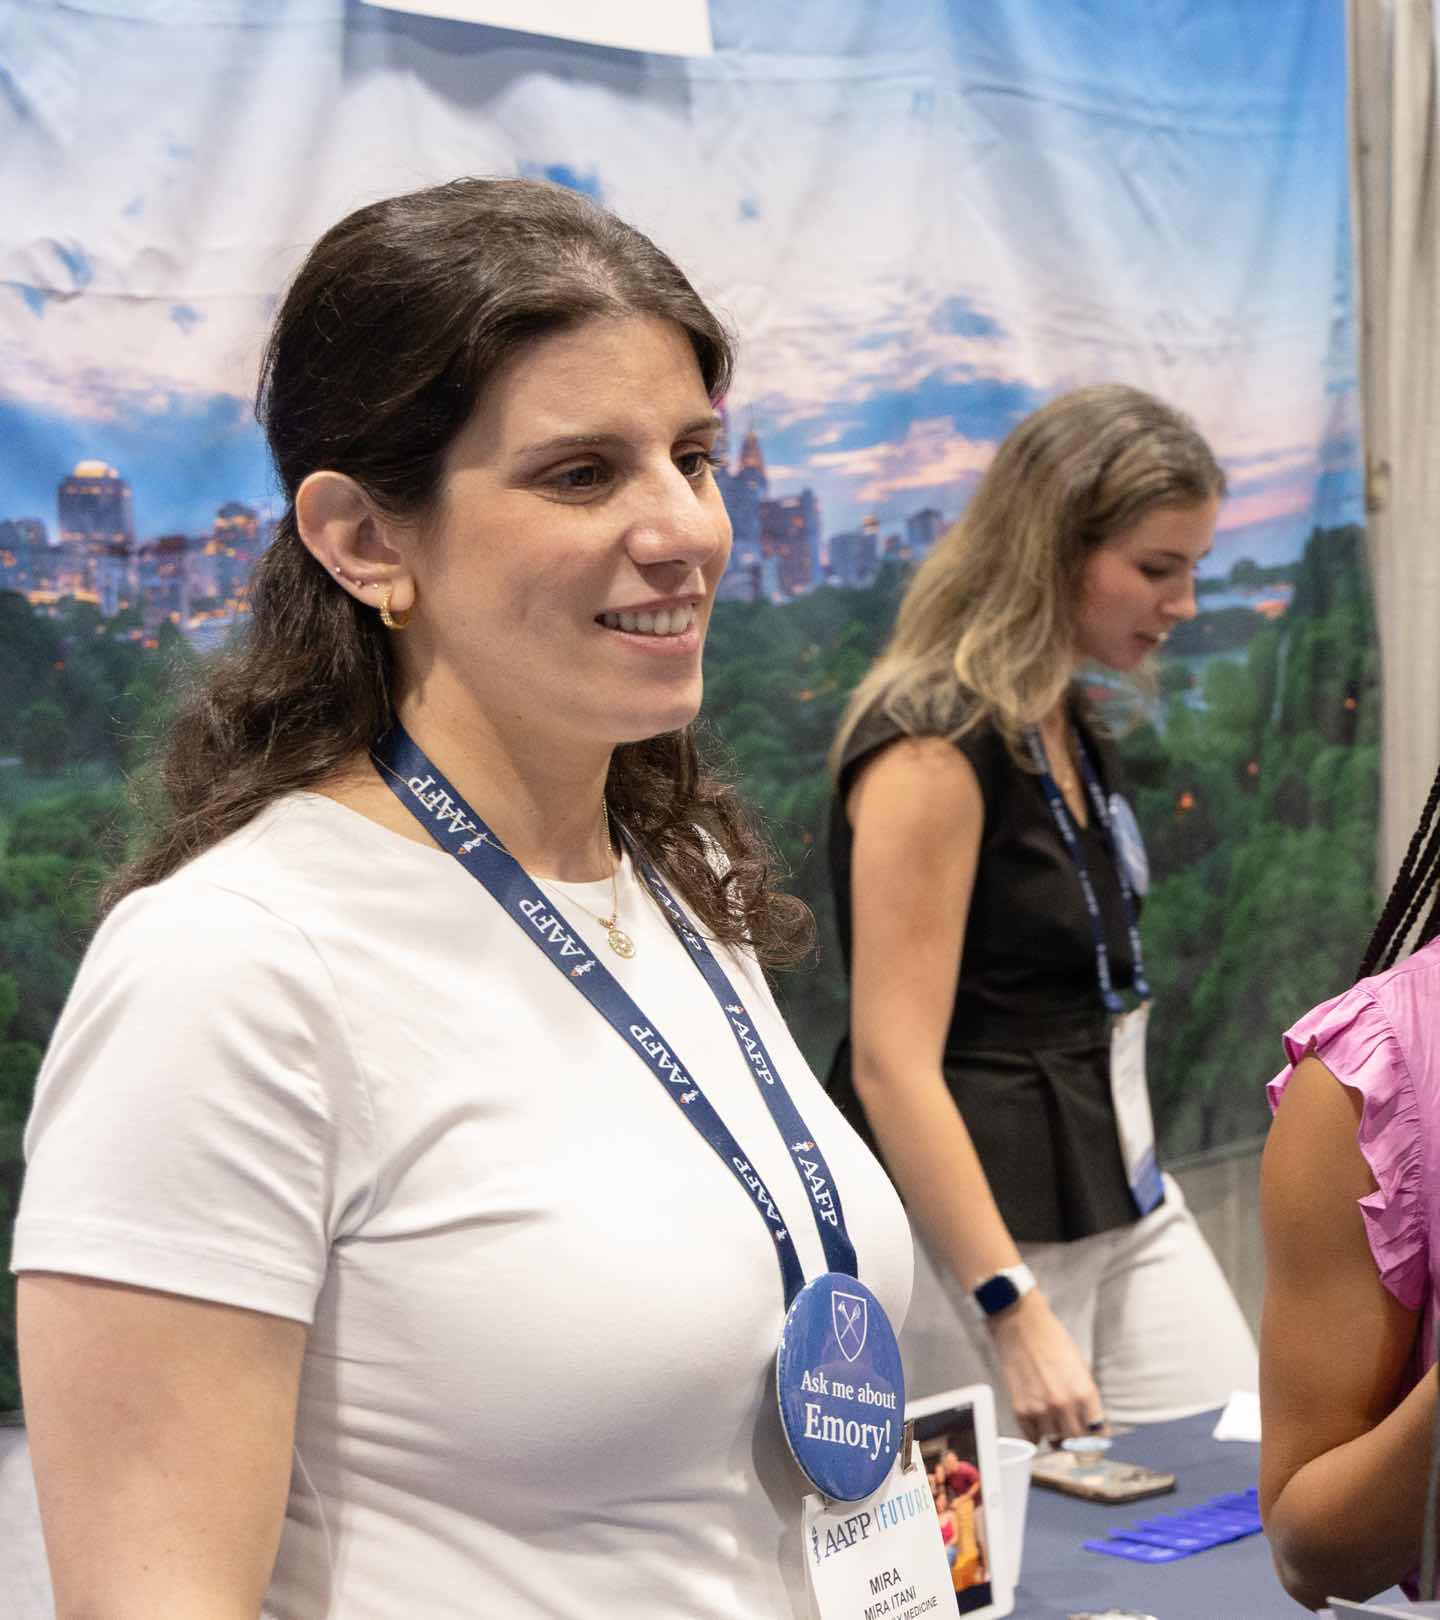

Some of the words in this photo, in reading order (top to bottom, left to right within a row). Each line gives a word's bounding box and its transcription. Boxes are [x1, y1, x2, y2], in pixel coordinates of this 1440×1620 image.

[407, 774, 477, 834] AAFP
[518, 898, 586, 959] AAFP
[629, 1024, 691, 1086] AAFP
[732, 1016, 775, 1086] AAFP
[732, 1156, 782, 1224] AAFP
[798, 1155, 839, 1227] AAFP
[800, 1370, 830, 1395] Ask
[832, 1381, 854, 1400] me
[857, 1382, 897, 1410] about
[803, 1402, 892, 1461] Emory!
[824, 1511, 871, 1558] AAFP
[864, 1599, 891, 1620] MIRA
[891, 1585, 917, 1610] ITANI
[869, 1567, 902, 1596] MIRA
[904, 1595, 939, 1620] MEDICINE
